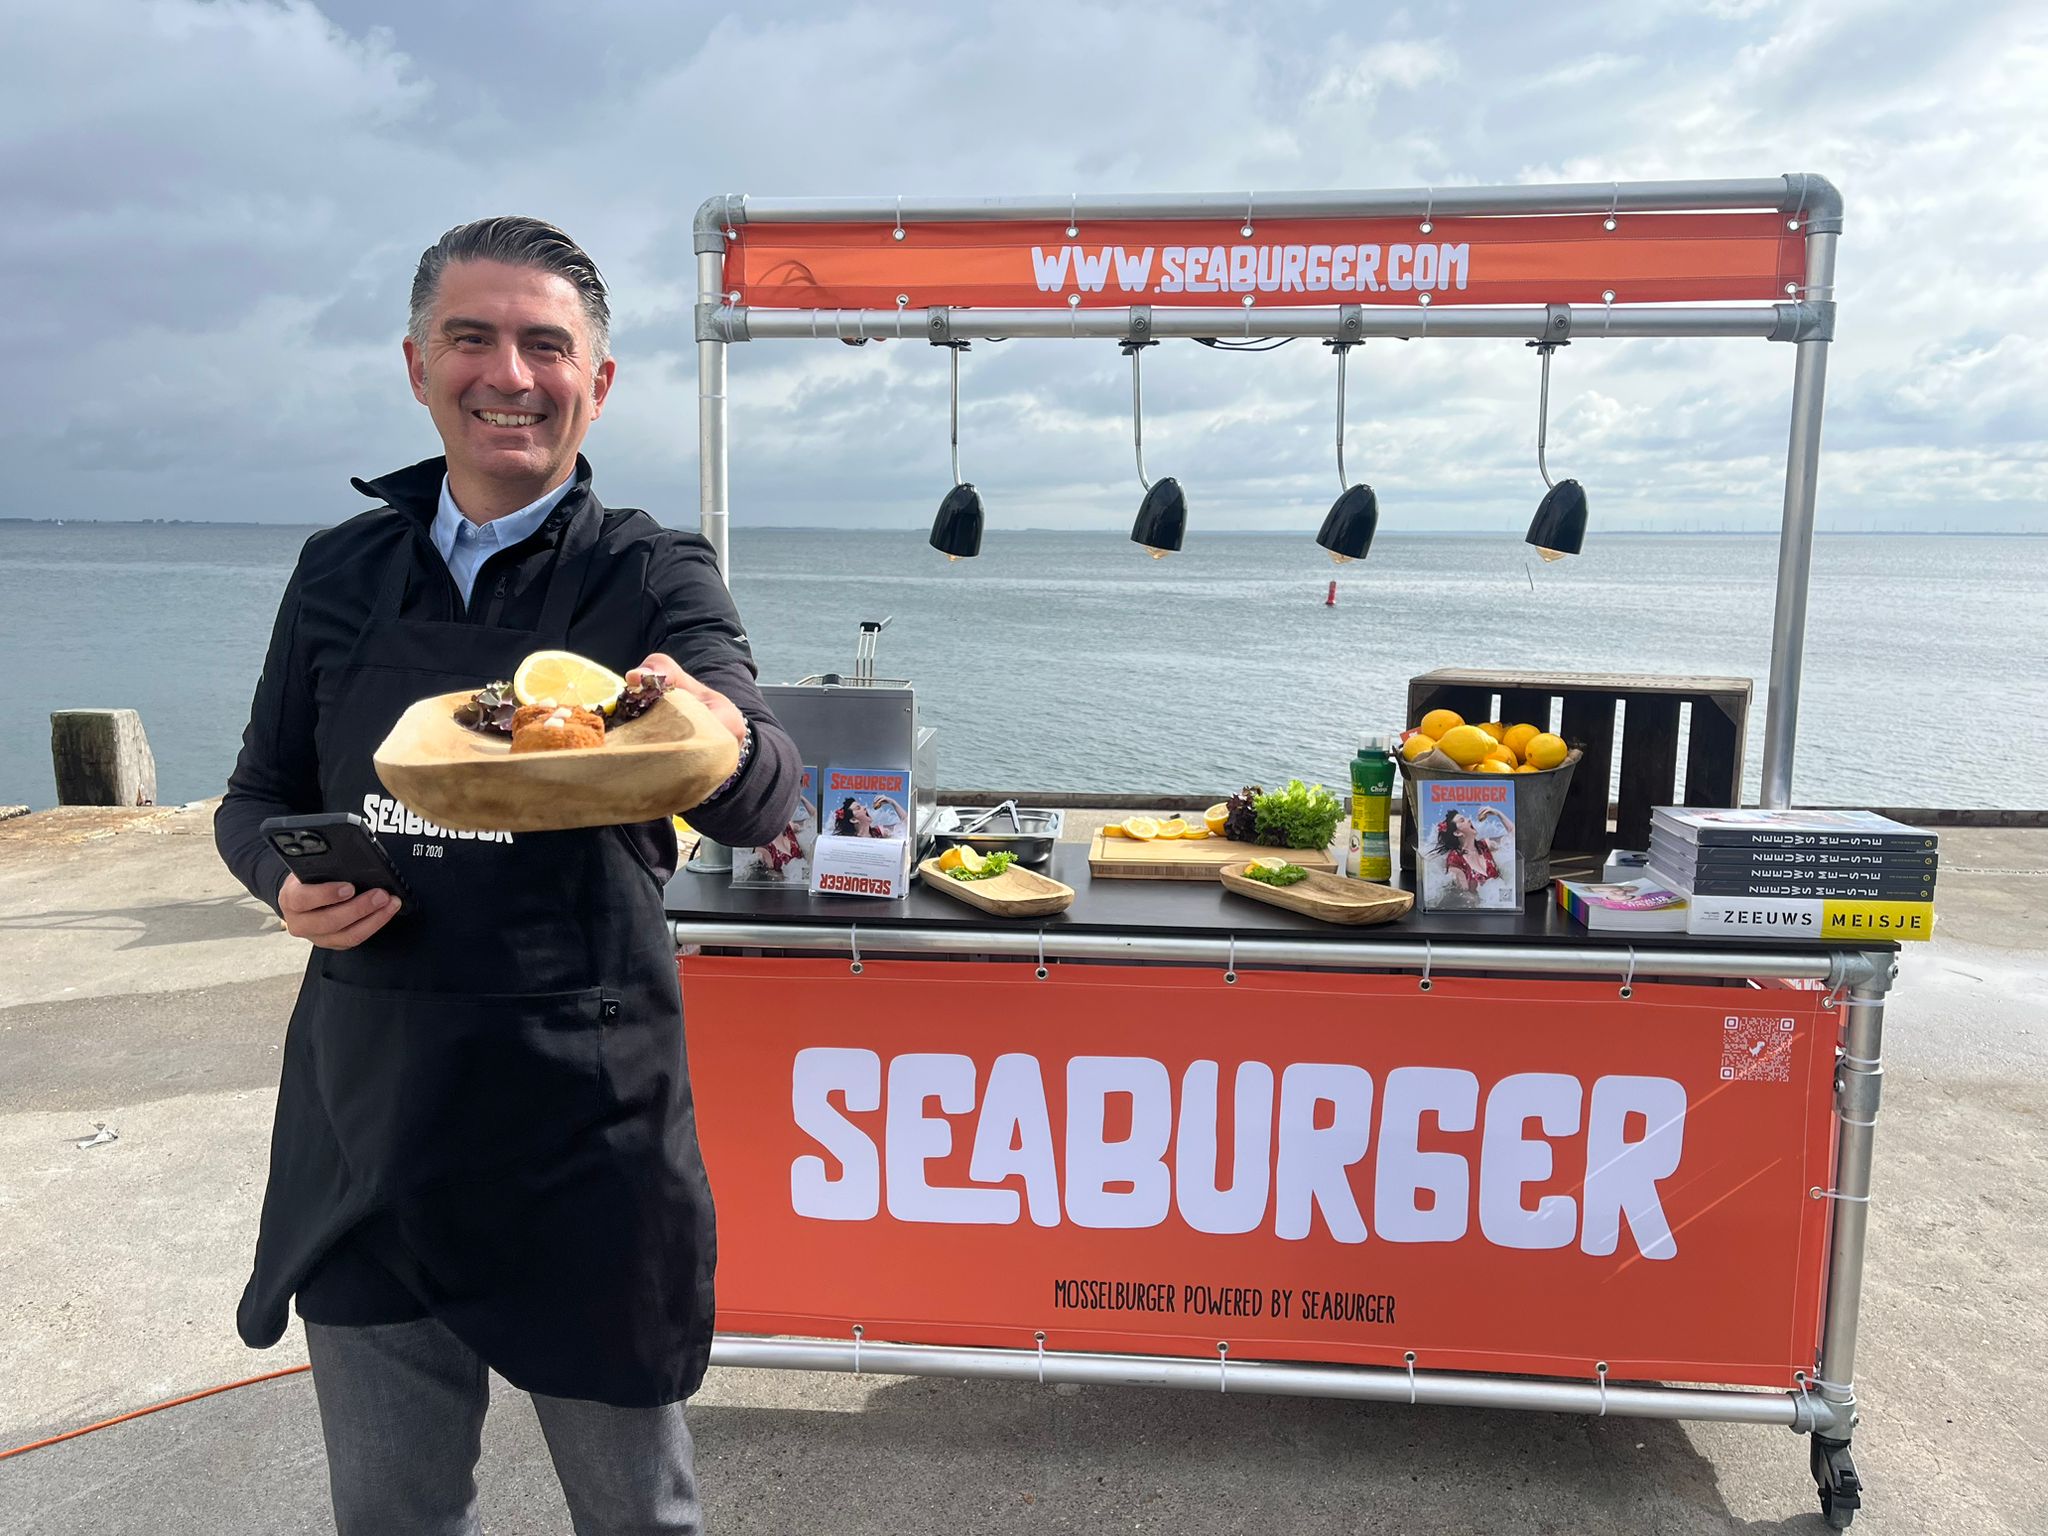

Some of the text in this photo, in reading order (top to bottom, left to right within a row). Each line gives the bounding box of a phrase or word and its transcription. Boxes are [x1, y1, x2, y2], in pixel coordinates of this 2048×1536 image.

[1031, 243, 1470, 293] WWW.SEABURGER.COM
[831, 773, 903, 791] SEABURGER
[1431, 784, 1507, 802] SEABURGER
[1752, 834, 1815, 845] ZEEUWS
[1820, 836, 1882, 846] MEISJE
[412, 844, 444, 858] EST 2020
[1753, 853, 1816, 863] ZEEUWS
[1820, 854, 1882, 864] MEISJE
[1751, 869, 1814, 879] ZEEUWS
[1818, 870, 1881, 880] MEISJE
[819, 873, 891, 895] SEABURGER
[1749, 885, 1812, 895] ZEEUWS
[1816, 886, 1879, 896] MEISJE
[1724, 910, 1813, 926] ZEEUWS
[1832, 913, 1921, 929] MEISJE
[791, 1048, 1687, 1261] SEABURGER
[1054, 1279, 1396, 1324] MOSSELBURGER POWERED BY SEABURGER
